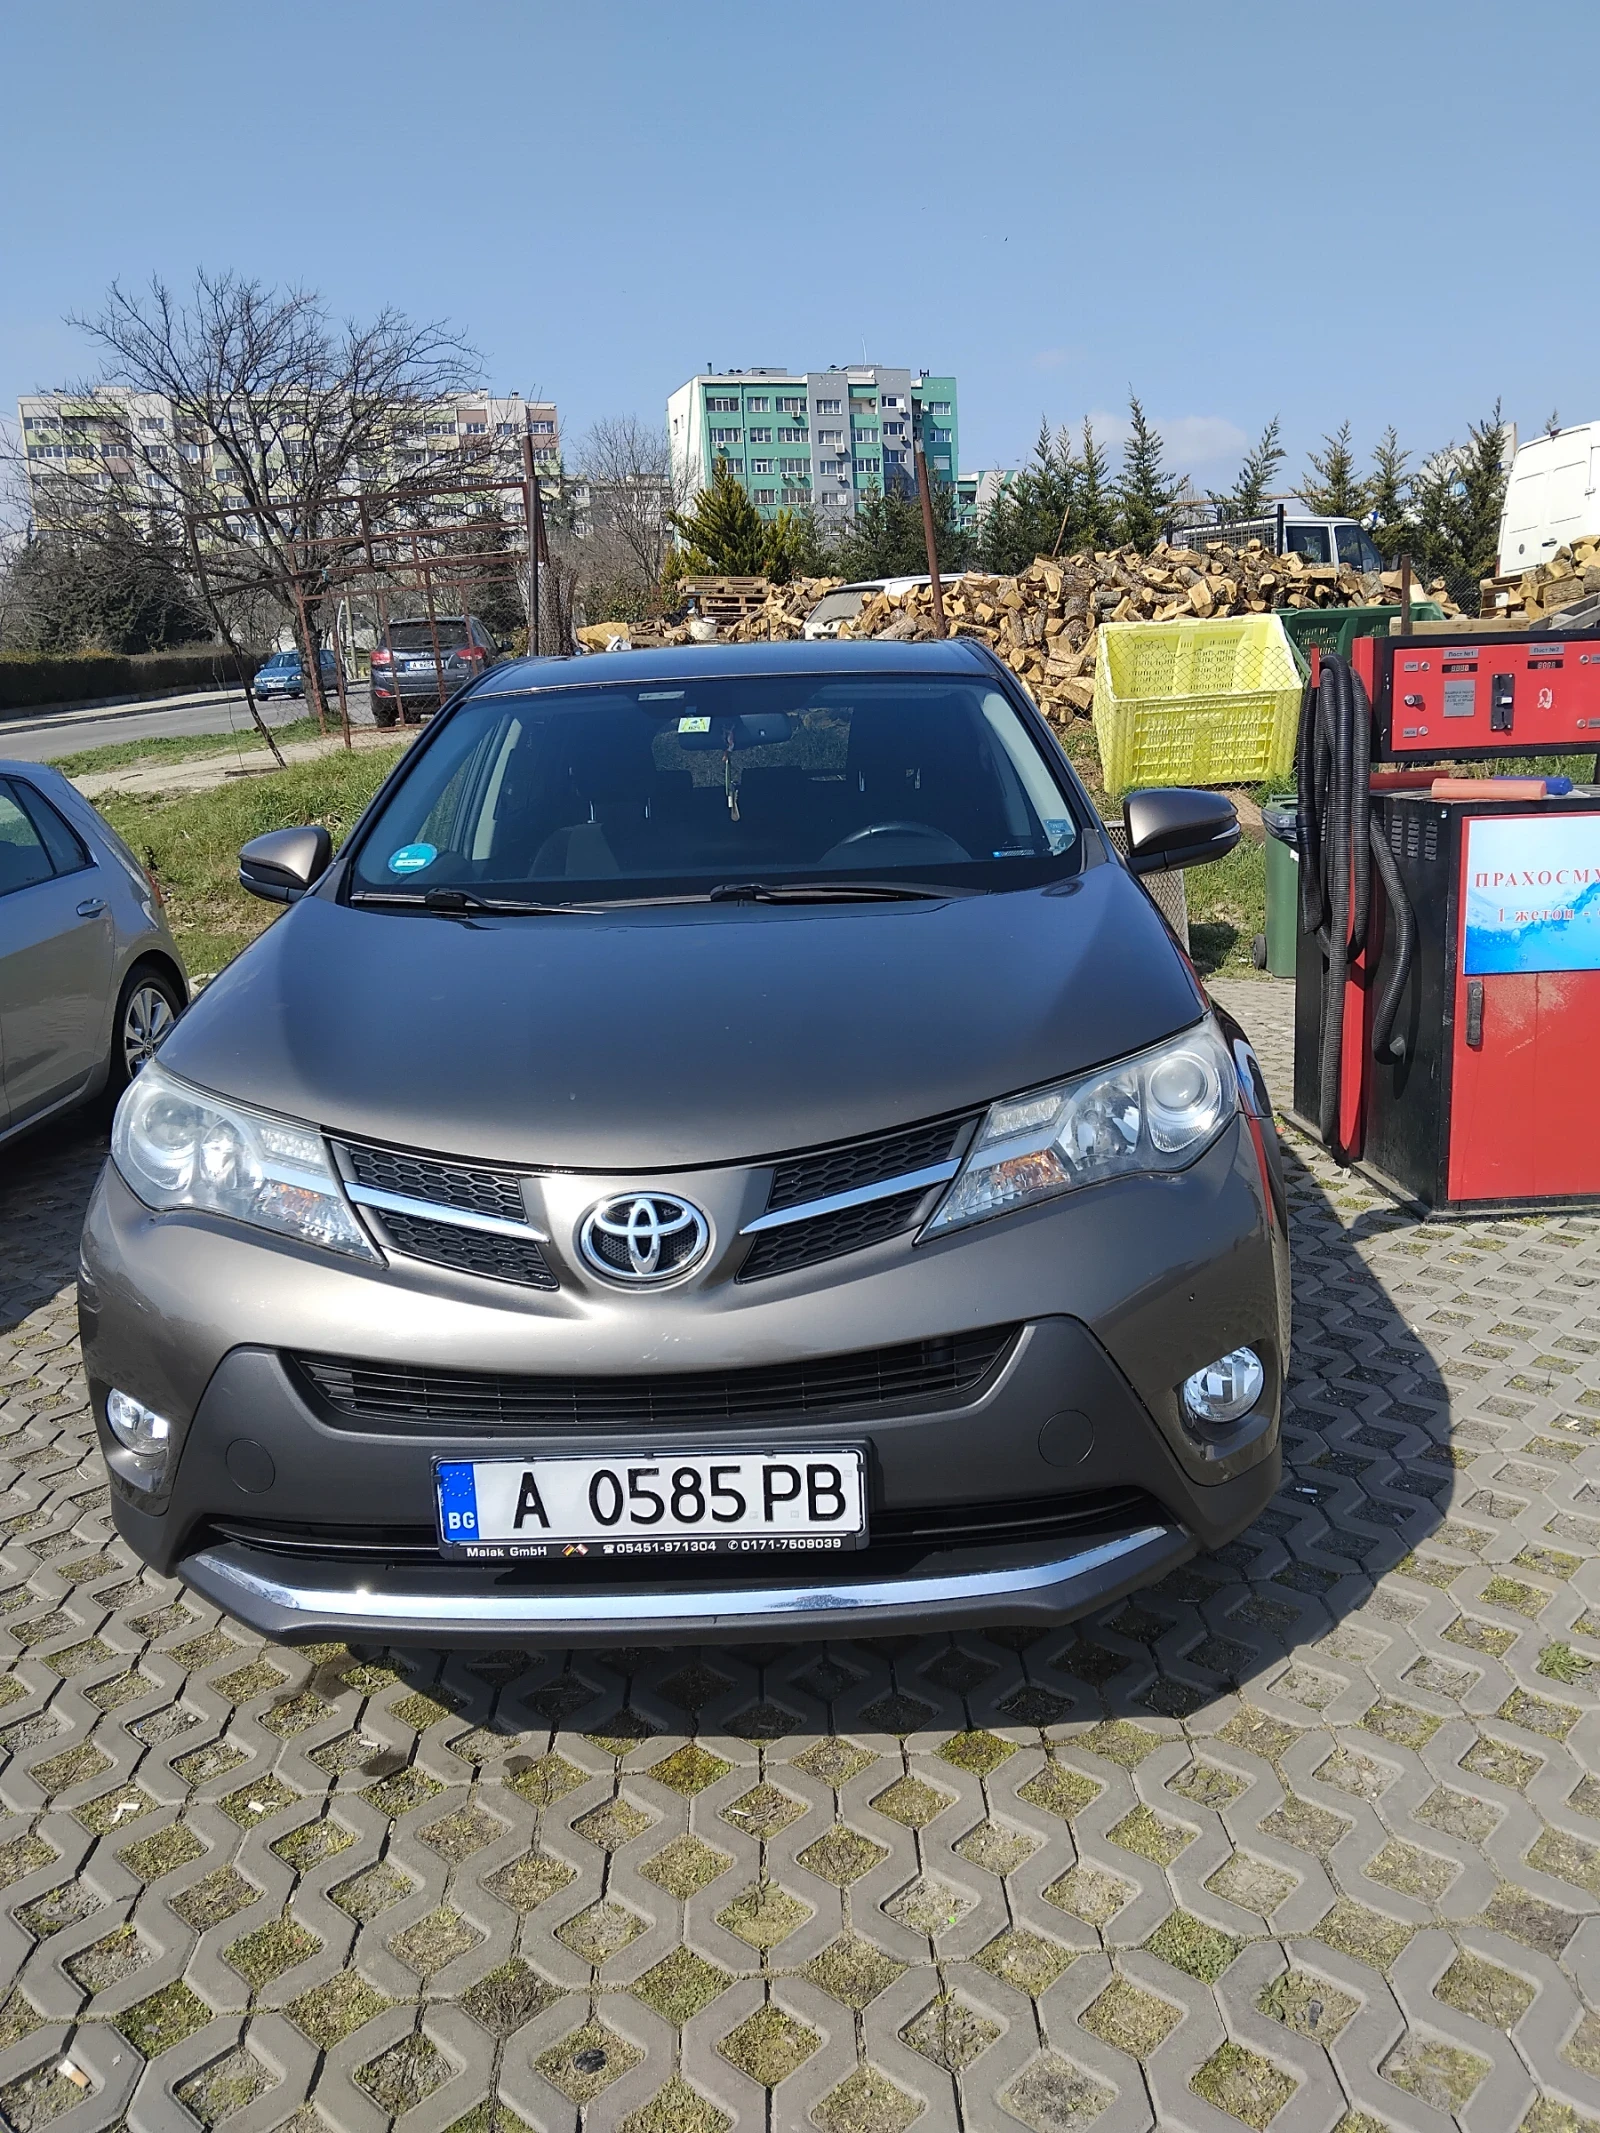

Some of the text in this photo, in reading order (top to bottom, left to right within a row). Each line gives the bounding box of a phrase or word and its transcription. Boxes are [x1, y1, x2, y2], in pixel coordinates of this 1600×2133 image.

[1498, 908, 1505, 922] 1
[1515, 909, 1575, 922] жетон
[513, 1463, 847, 1529] A 0585 PB
[448, 1511, 476, 1530] BG
[509, 1546, 548, 1557] GmbH
[616, 1540, 717, 1553] 05451-971304
